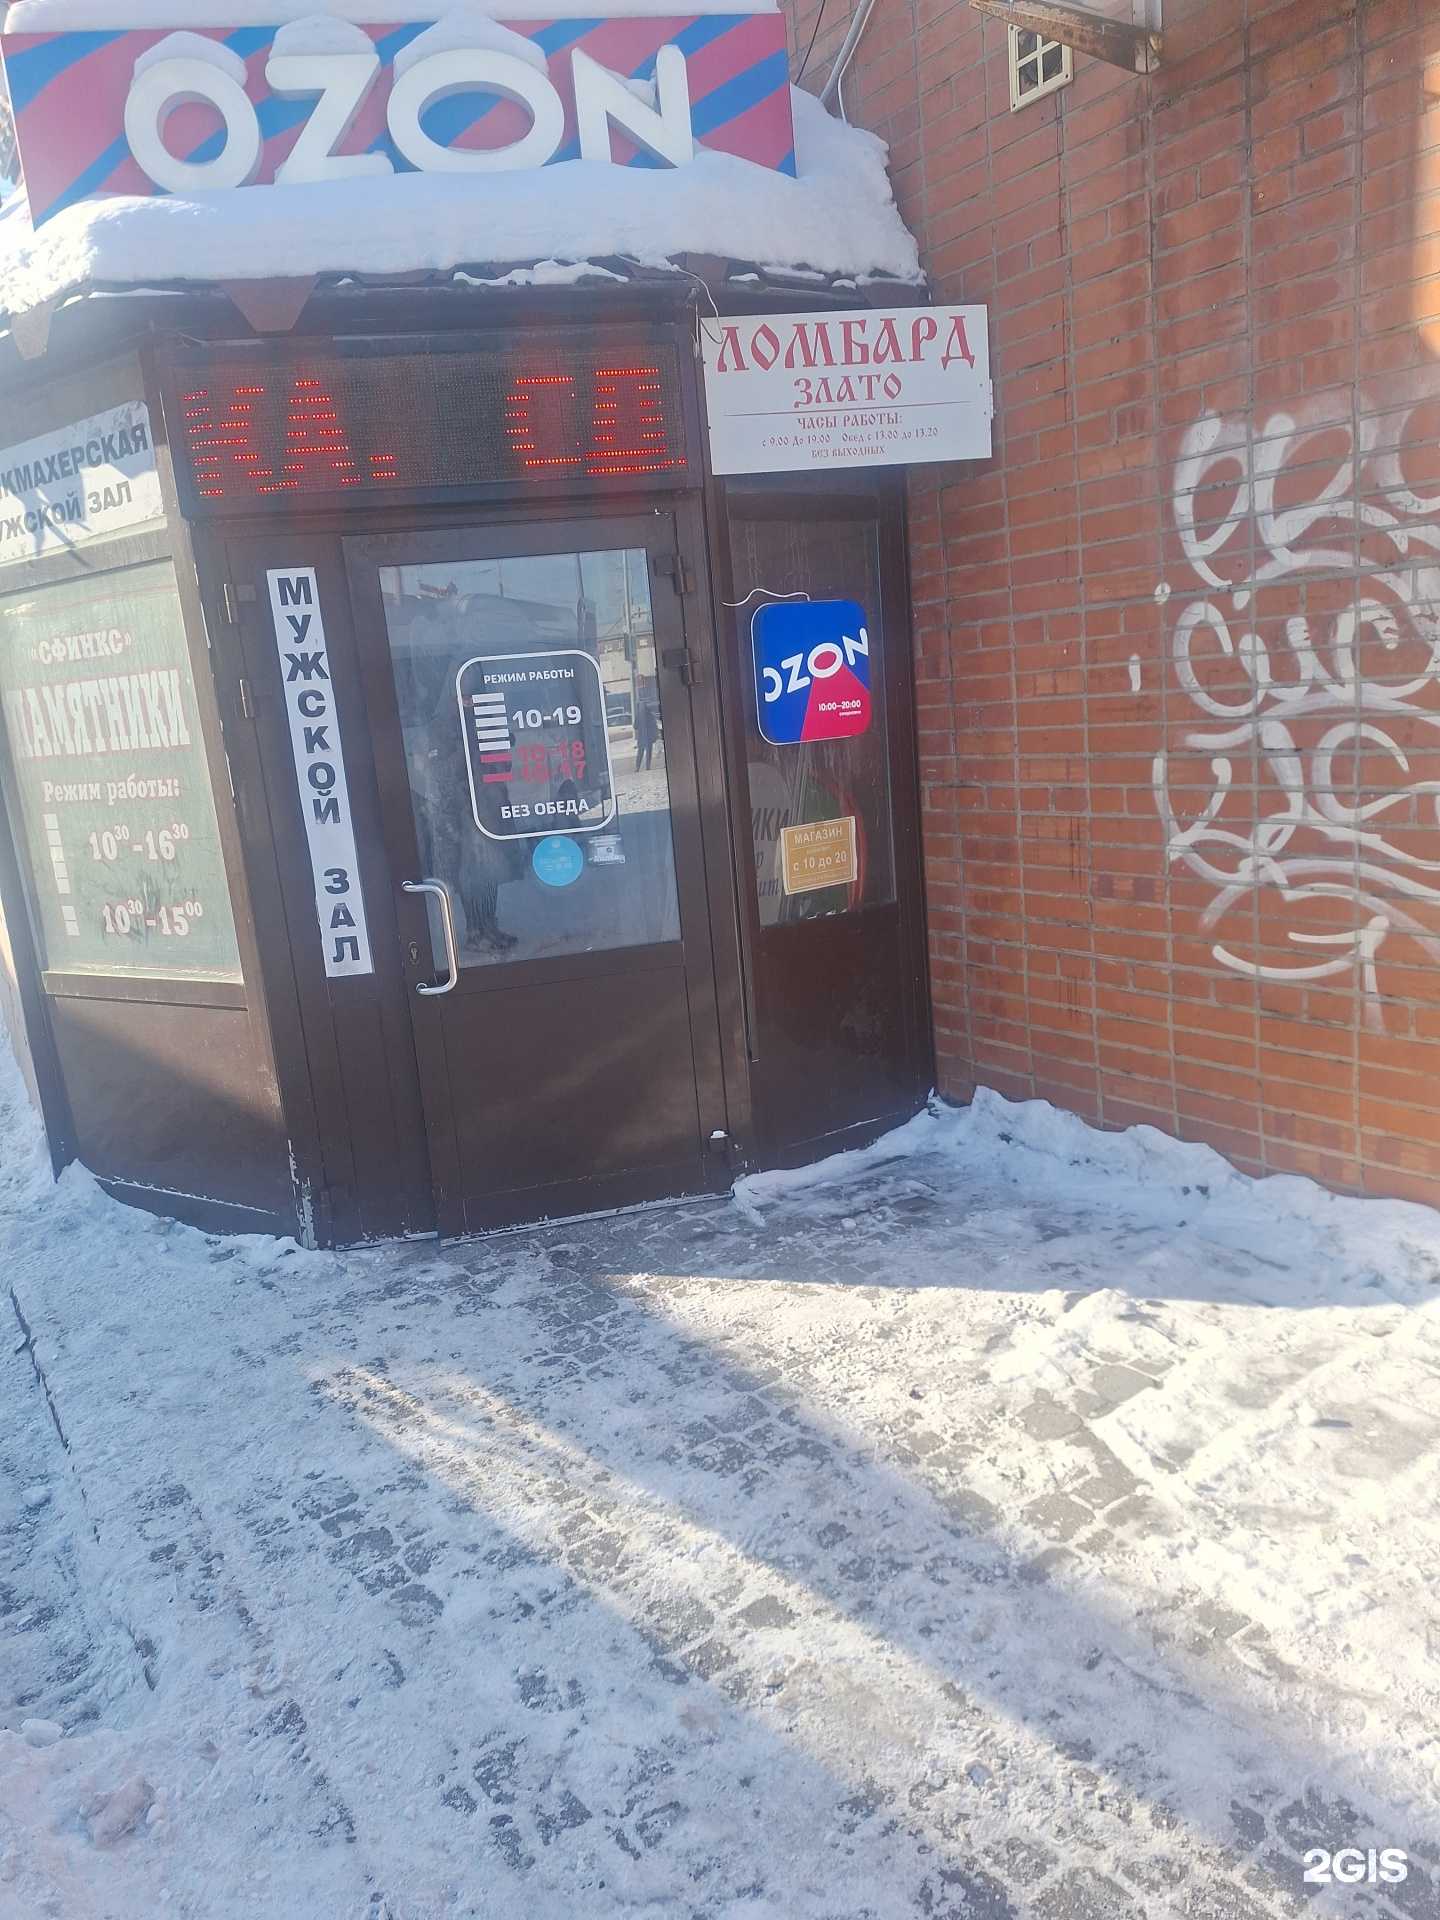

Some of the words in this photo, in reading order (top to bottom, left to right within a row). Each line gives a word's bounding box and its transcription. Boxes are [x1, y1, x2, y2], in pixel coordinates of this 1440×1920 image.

[124, 43, 696, 194] OZON
[716, 315, 976, 373] ЛОМБАРД
[793, 372, 903, 409] ЗЛАТО
[797, 418, 838, 430] ЧАСЫ
[843, 413, 904, 428] РАБОТЫ:
[0, 423, 148, 498] КМАХЕРСКАЯ
[87, 481, 132, 514] ЗАЛ
[484, 674, 527, 684] РЕЖИМ
[529, 668, 575, 681] РАБОТЫ
[7, 669, 191, 758] ПАМЯТНИКИ
[512, 705, 582, 729] 10-19
[277, 576, 341, 826] МУЖСКОЙ
[321, 868, 361, 964] ЗАЛ
[42, 781, 101, 803] Режим
[107, 773, 180, 806] работы:
[500, 804, 531, 819] БЕЗ
[533, 798, 590, 816] ОБЕДА
[794, 826, 843, 845] МАГАЗИН
[803, 856, 816, 869] 10
[818, 856, 832, 869] до
[834, 850, 847, 863] 20
